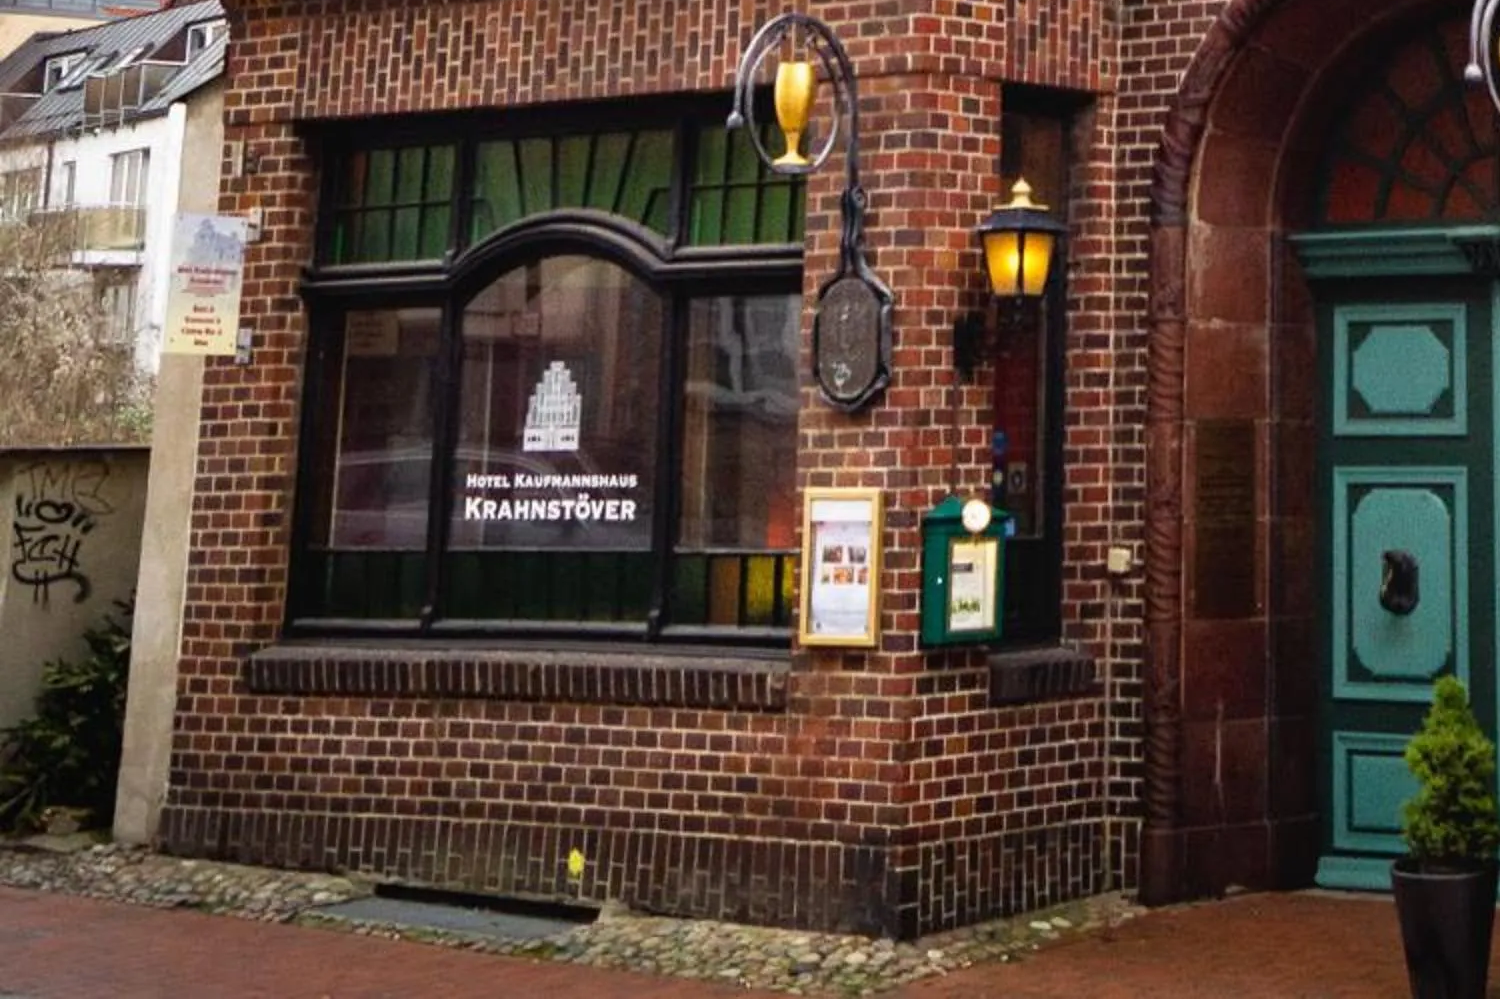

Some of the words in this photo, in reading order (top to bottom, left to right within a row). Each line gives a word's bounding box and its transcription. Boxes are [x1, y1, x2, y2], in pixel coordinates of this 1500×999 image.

[466, 473, 511, 488] HOTEL
[514, 473, 638, 488] KAUFMANNSHAUS
[464, 493, 637, 521] KRAHNSTÖVER
